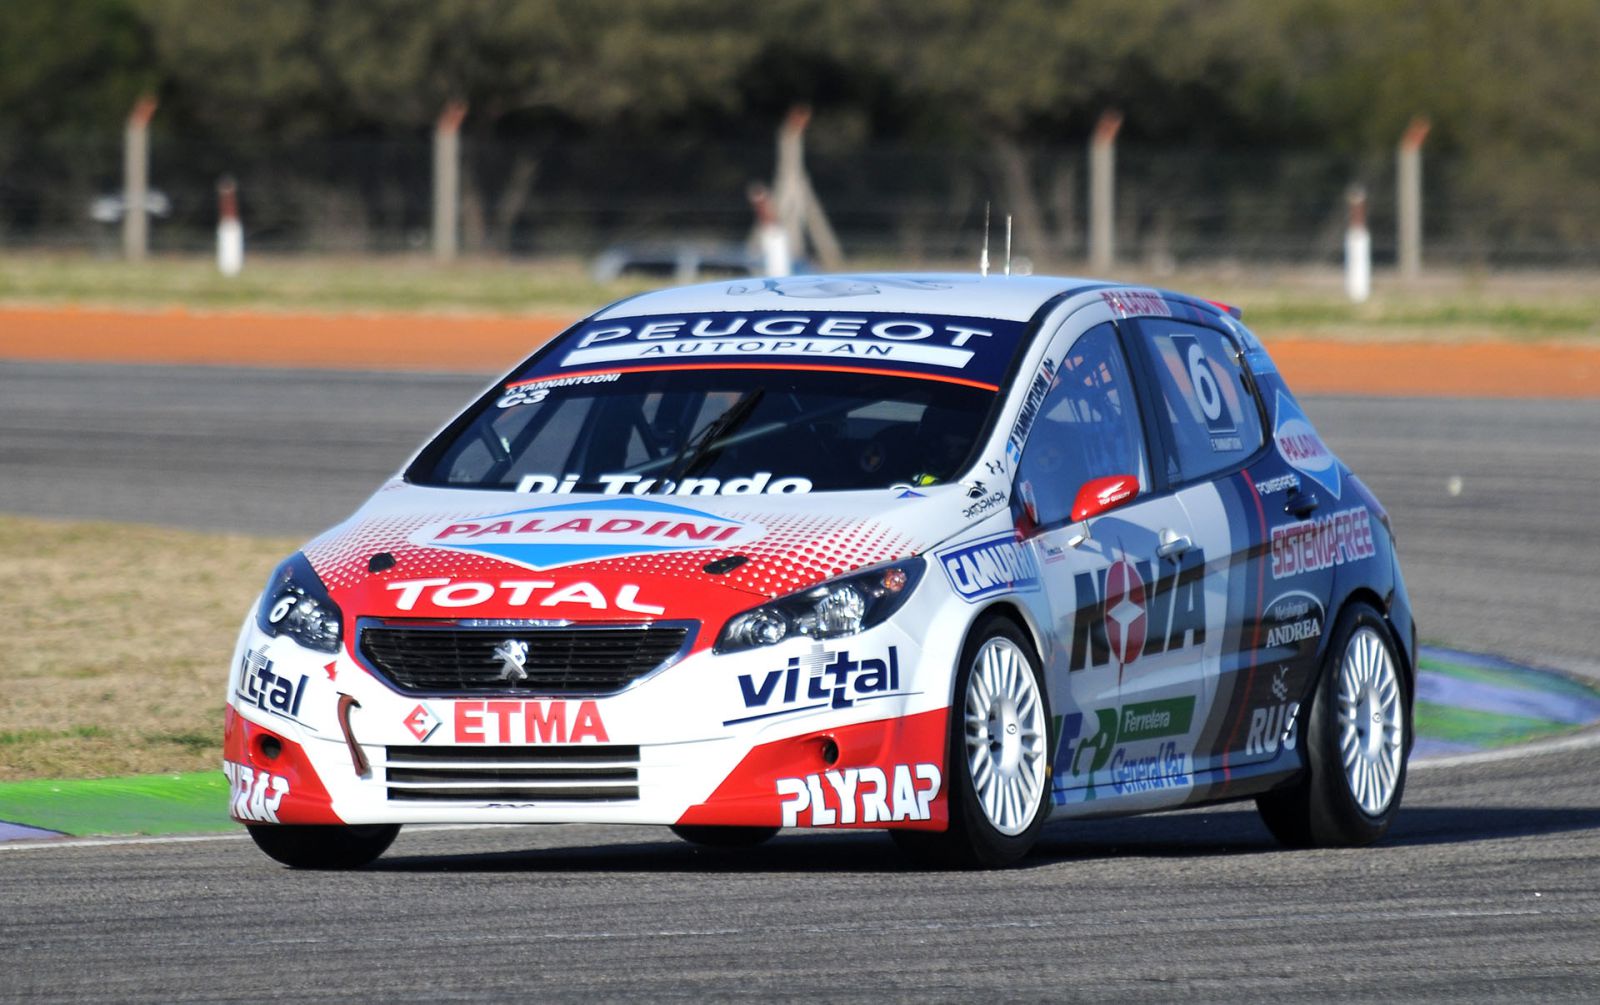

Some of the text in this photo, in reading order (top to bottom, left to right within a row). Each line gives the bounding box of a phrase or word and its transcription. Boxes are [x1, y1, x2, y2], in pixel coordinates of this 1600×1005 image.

[577, 316, 993, 349] PEUGEOT
[640, 339, 896, 357] AUTOPLAN
[497, 389, 550, 409] C3
[1188, 344, 1221, 420] 6
[515, 472, 581, 495] Di
[434, 517, 743, 542] PALADINI
[1271, 506, 1376, 580] SISTEMAFREE
[269, 596, 297, 623] 6
[387, 578, 665, 616] TOTAL
[1070, 549, 1206, 672] NOVA
[1266, 618, 1321, 648] ANDREA
[737, 644, 900, 710] vittal
[454, 701, 610, 743] ETMA
[1110, 741, 1189, 794] General Paz
[776, 762, 942, 828] PLYRAP
